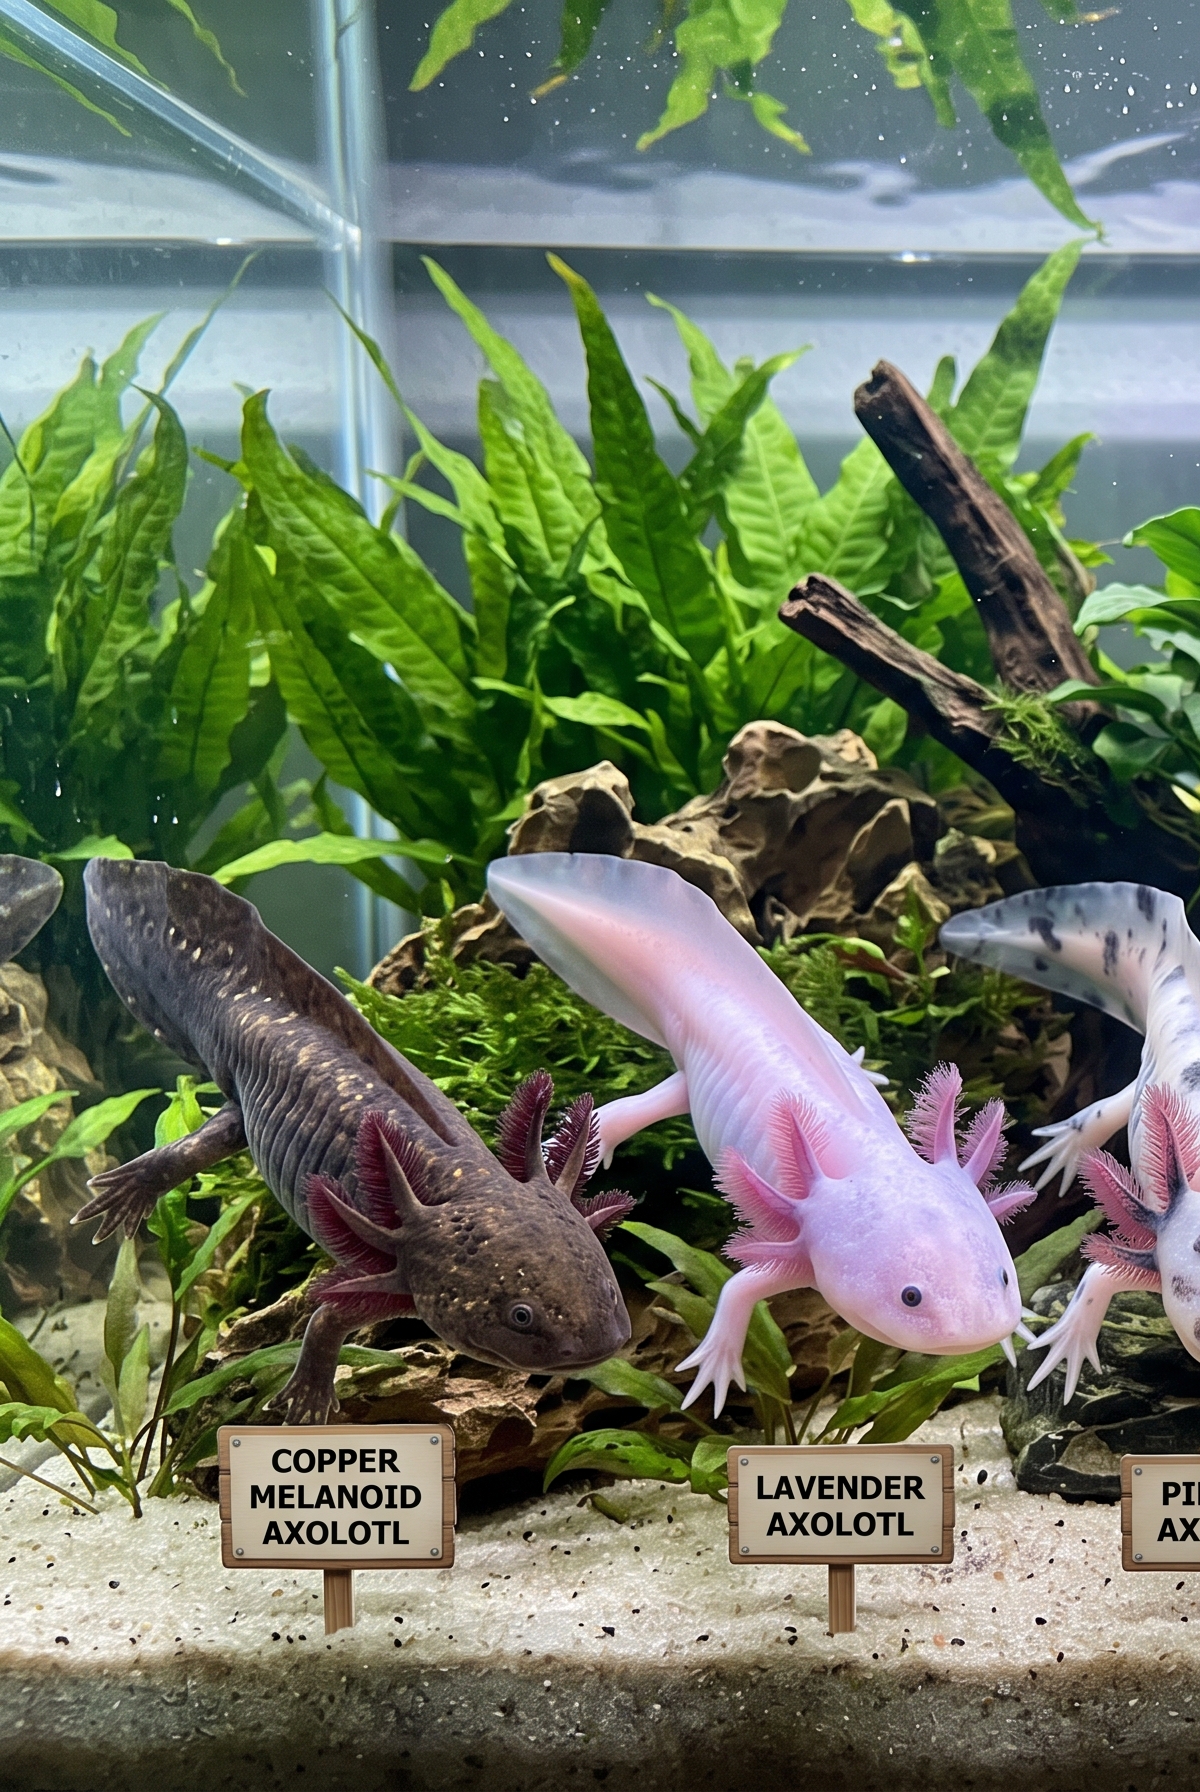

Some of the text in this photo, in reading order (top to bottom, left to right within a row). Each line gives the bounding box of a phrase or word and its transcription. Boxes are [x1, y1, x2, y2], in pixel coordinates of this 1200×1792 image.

[271, 1448, 400, 1473] COPPER
[250, 1485, 422, 1509] MELANOID
[757, 1476, 925, 1500] LAVENDER
[262, 1521, 410, 1545] AXOLOTL
[766, 1512, 915, 1536] AXOLOTL
